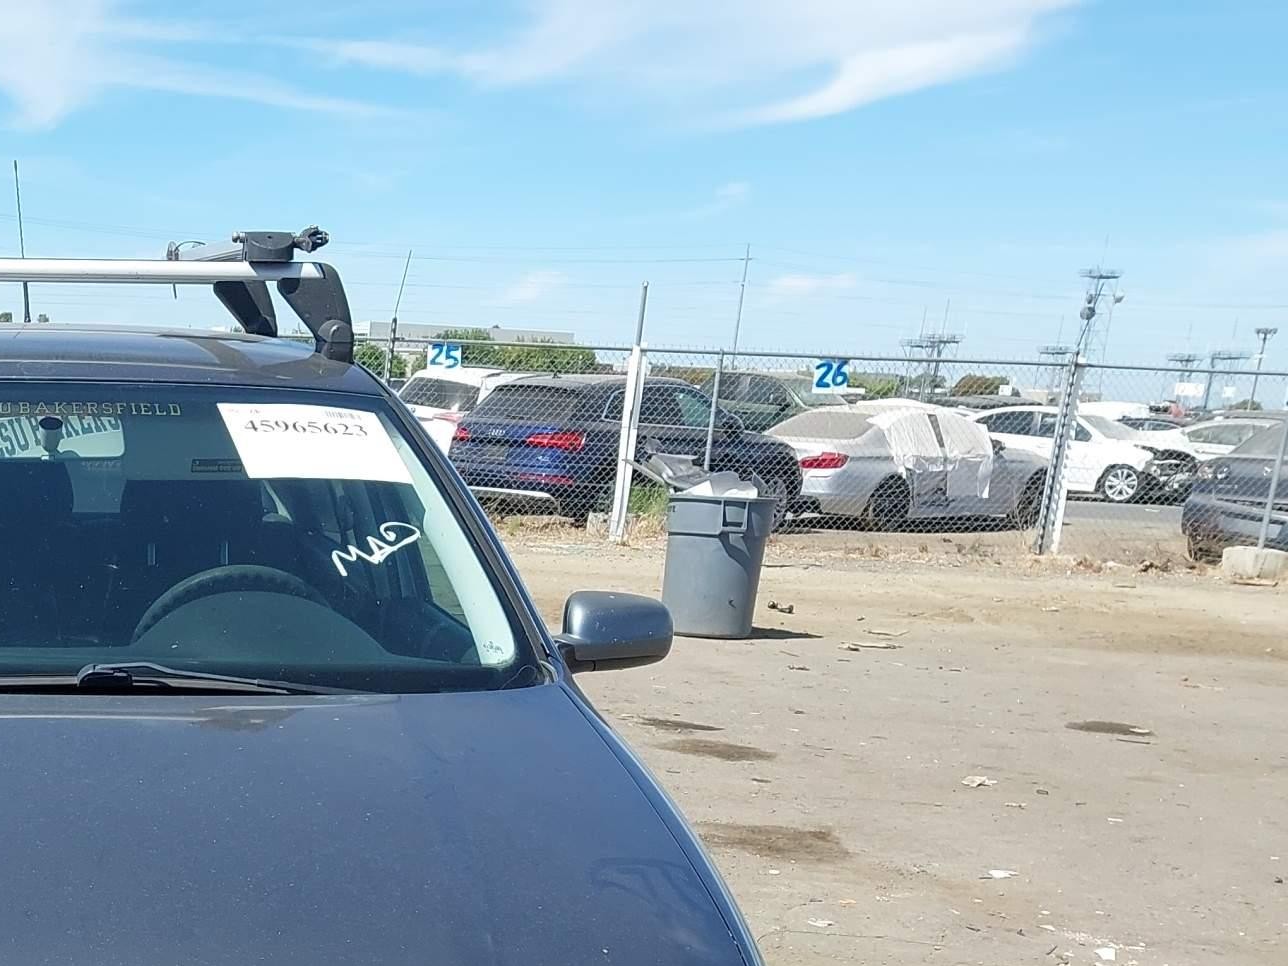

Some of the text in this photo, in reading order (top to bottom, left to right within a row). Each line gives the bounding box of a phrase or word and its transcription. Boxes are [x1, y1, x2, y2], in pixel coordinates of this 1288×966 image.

[429, 343, 460, 369] 25
[815, 359, 849, 388] 26
[18, 402, 182, 416] BAKERSFIELD
[244, 409, 369, 437] 45965623
